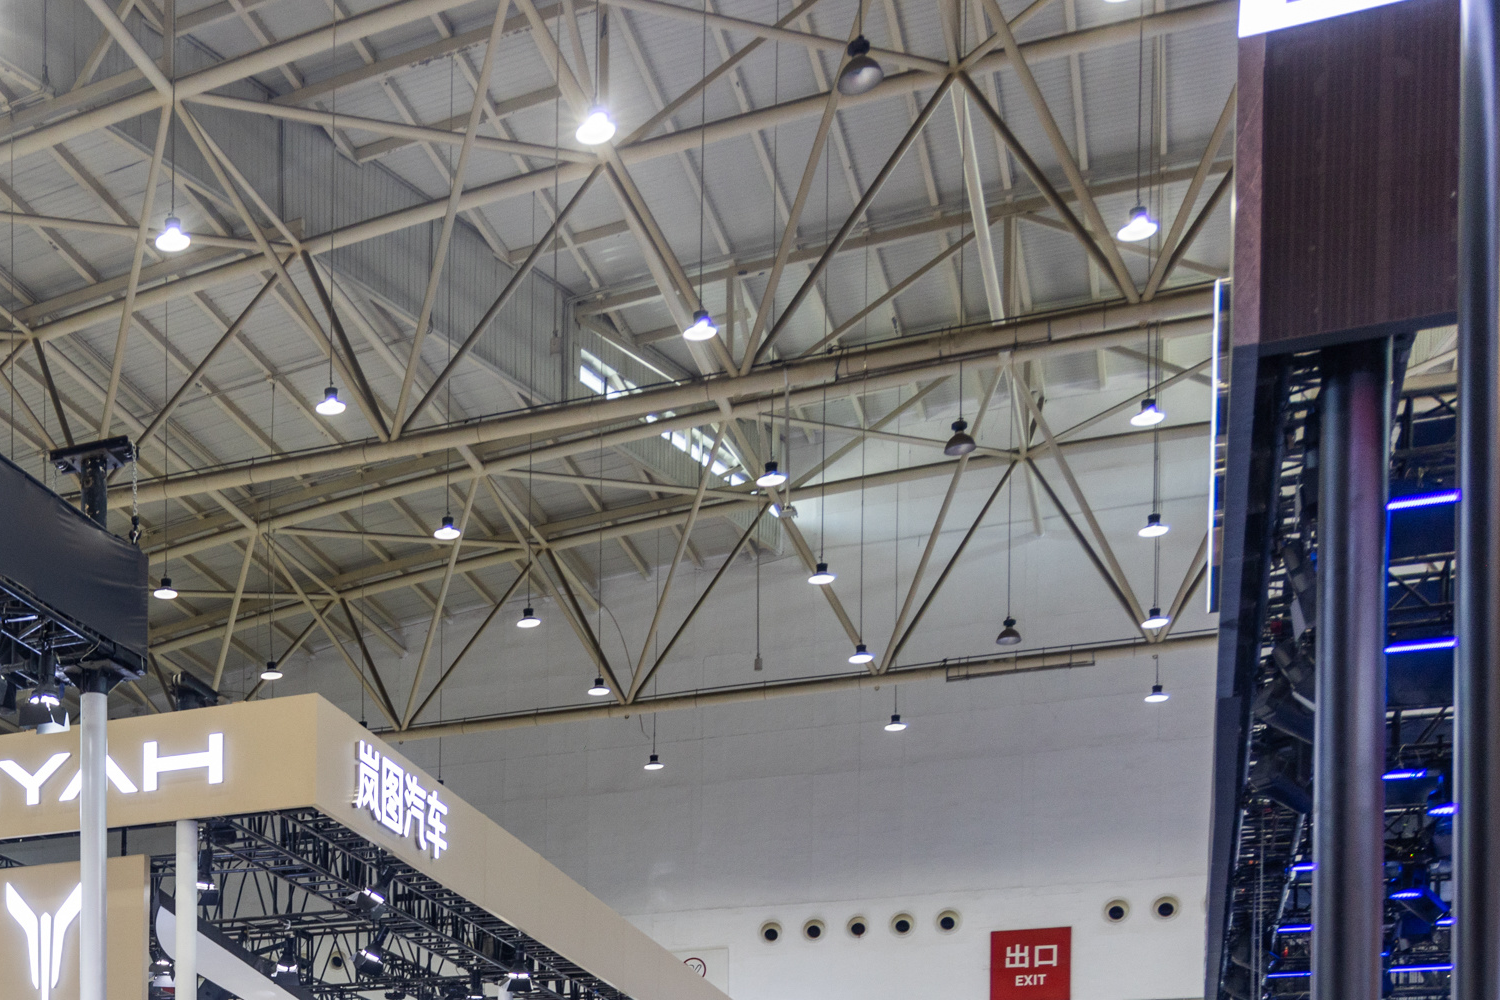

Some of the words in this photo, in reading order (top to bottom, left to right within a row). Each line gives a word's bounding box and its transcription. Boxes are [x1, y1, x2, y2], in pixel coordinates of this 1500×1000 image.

[355, 739, 448, 859] 岚图汽车
[1005, 944, 1058, 968] 出口
[1015, 973, 1047, 986] EXIT
